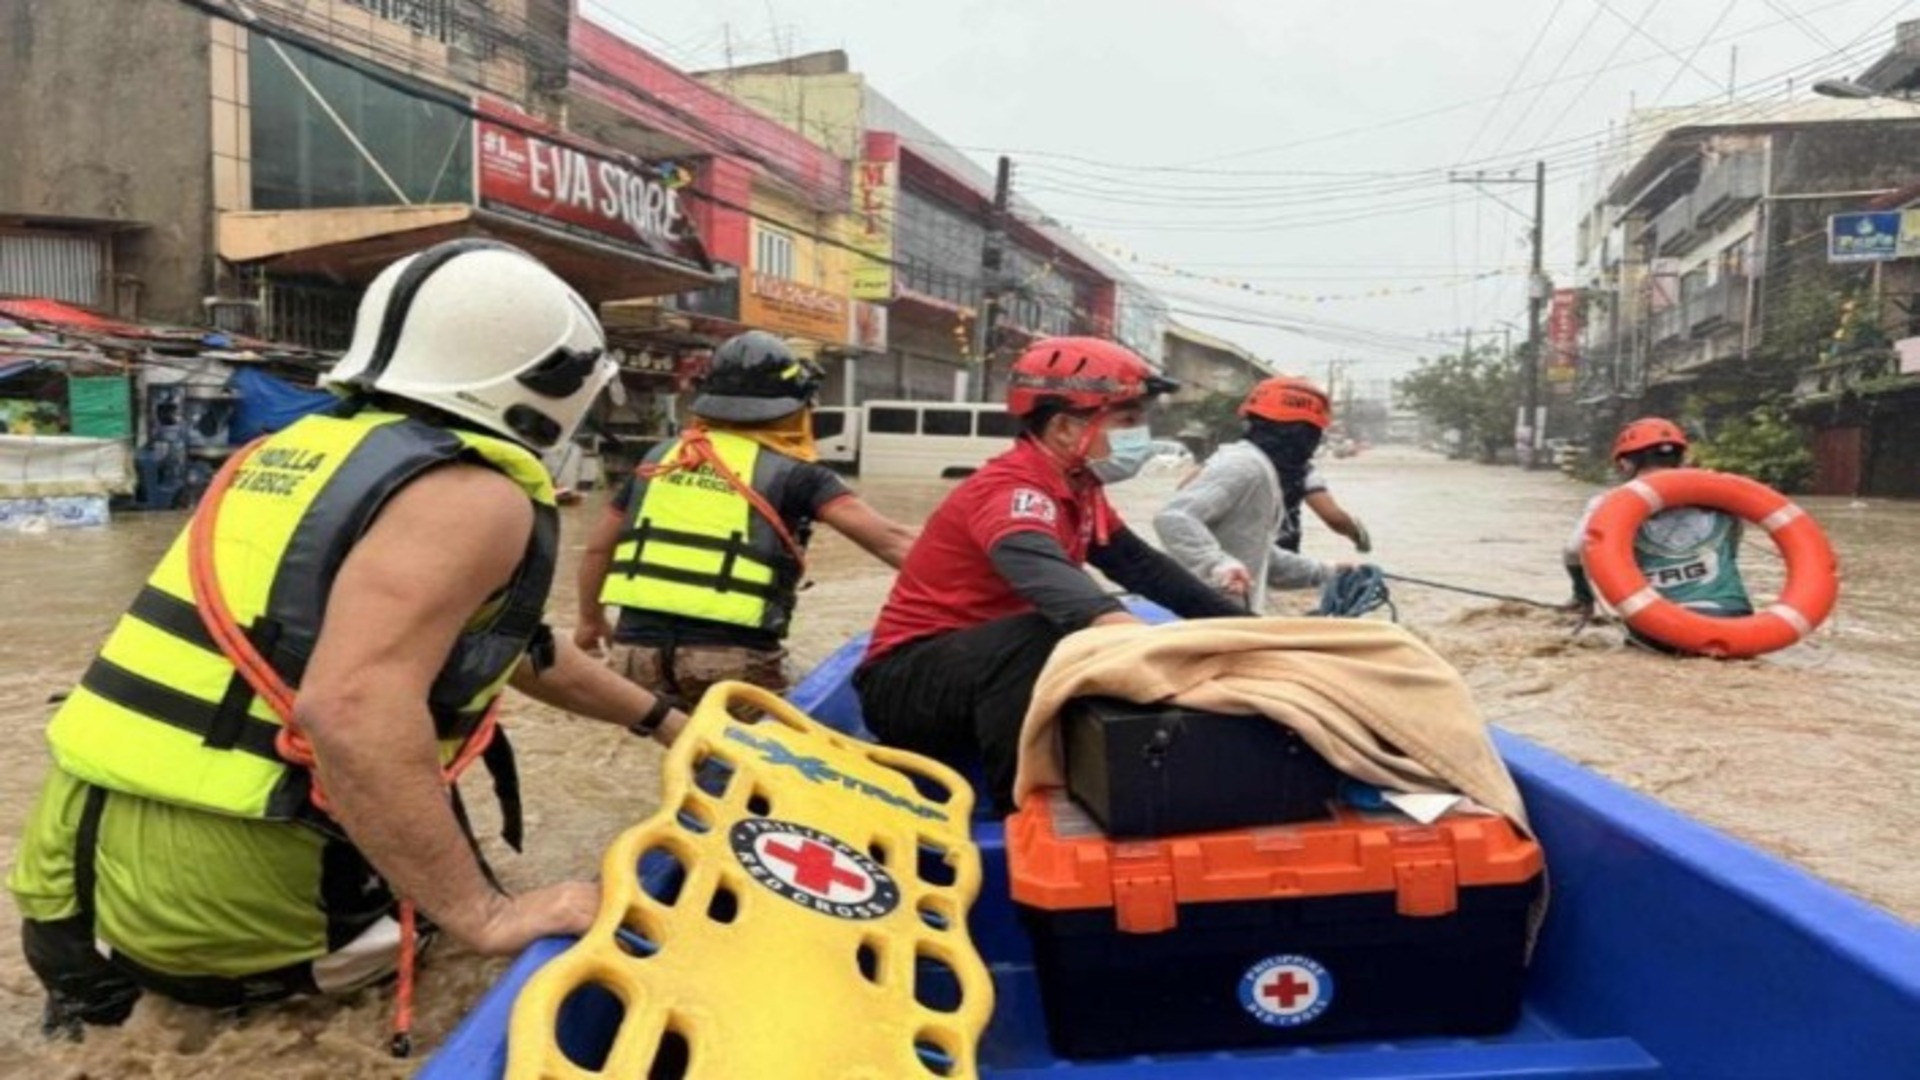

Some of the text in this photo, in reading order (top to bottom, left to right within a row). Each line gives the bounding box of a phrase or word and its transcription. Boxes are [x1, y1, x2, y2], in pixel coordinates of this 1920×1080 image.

[528, 137, 683, 241] EVA STORE
[743, 821, 889, 883] PHILIPPINE
[739, 851, 886, 918] RED CROSS
[1245, 954, 1326, 981] PHILIPPINE
[1247, 1001, 1328, 1026] RED CROSS
